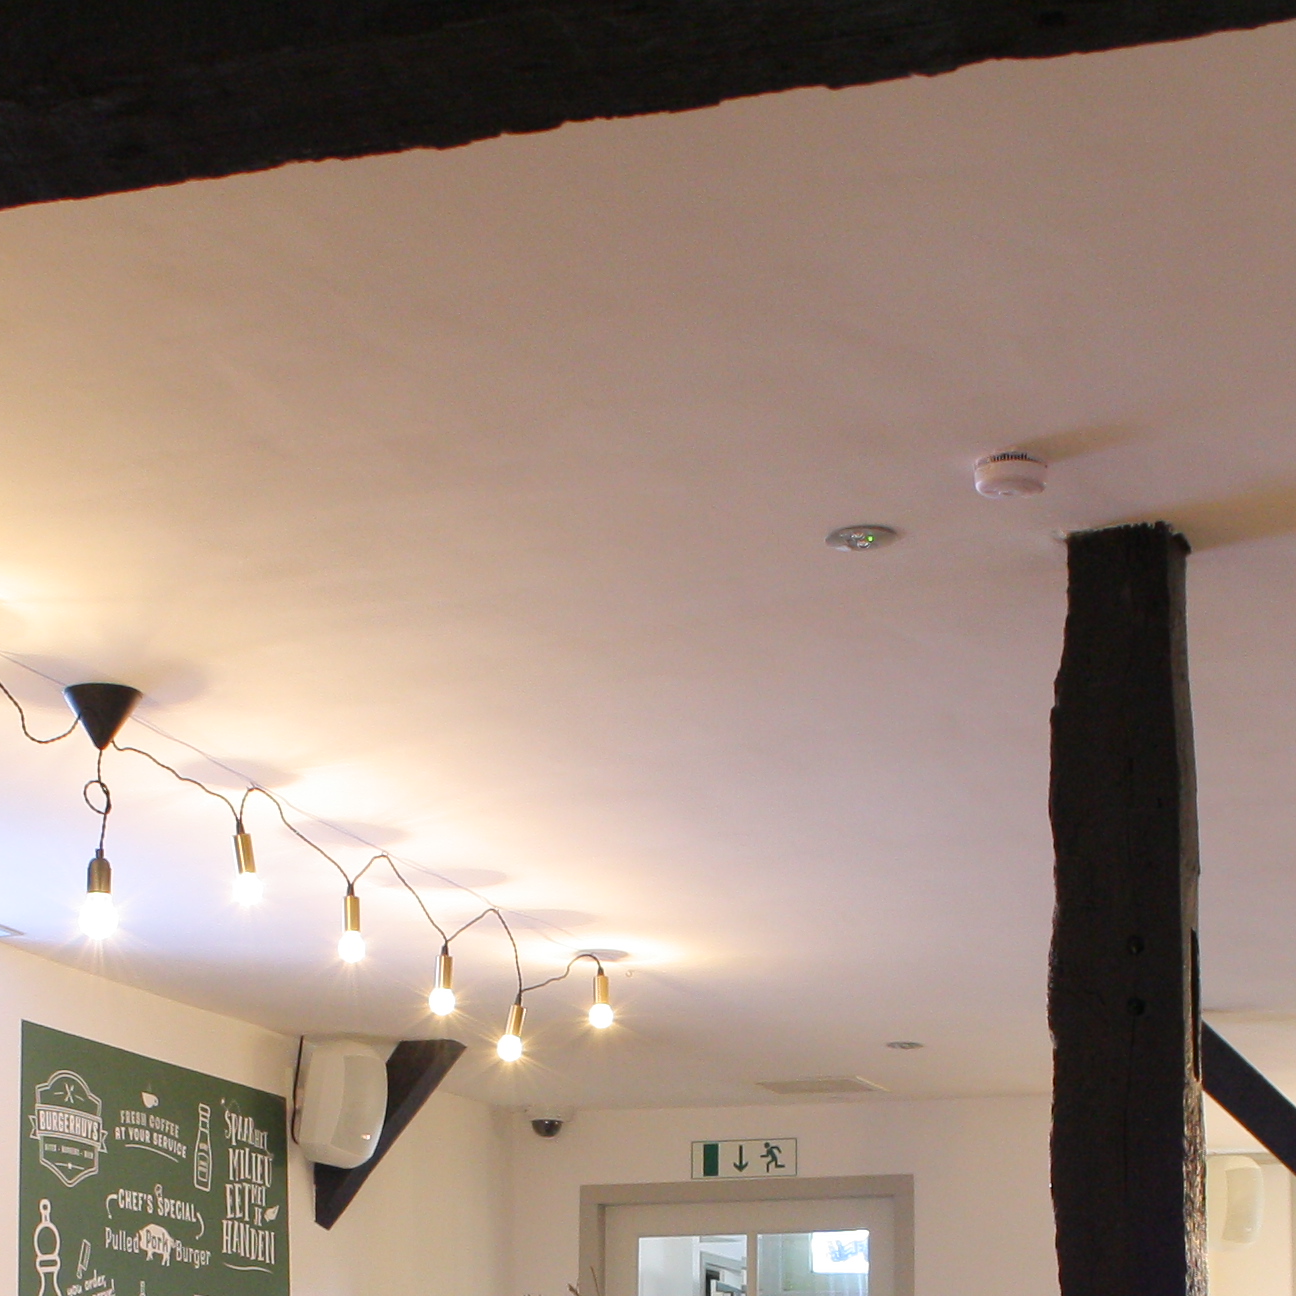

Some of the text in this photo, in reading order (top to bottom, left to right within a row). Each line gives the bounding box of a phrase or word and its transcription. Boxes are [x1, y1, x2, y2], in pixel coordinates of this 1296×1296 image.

[39, 1109, 99, 1141] BURGERHUYS
[115, 1126, 187, 1159] AT YOUR SERVICE
[120, 1109, 180, 1139] FRESH COFFEE
[228, 1147, 273, 1188] MILIEU
[118, 1188, 197, 1223] CHEF'S SPECIAL
[225, 1181, 252, 1222] EET
[105, 1226, 211, 1269] Pulled Pork Burger
[221, 1219, 275, 1266] HANDEN
